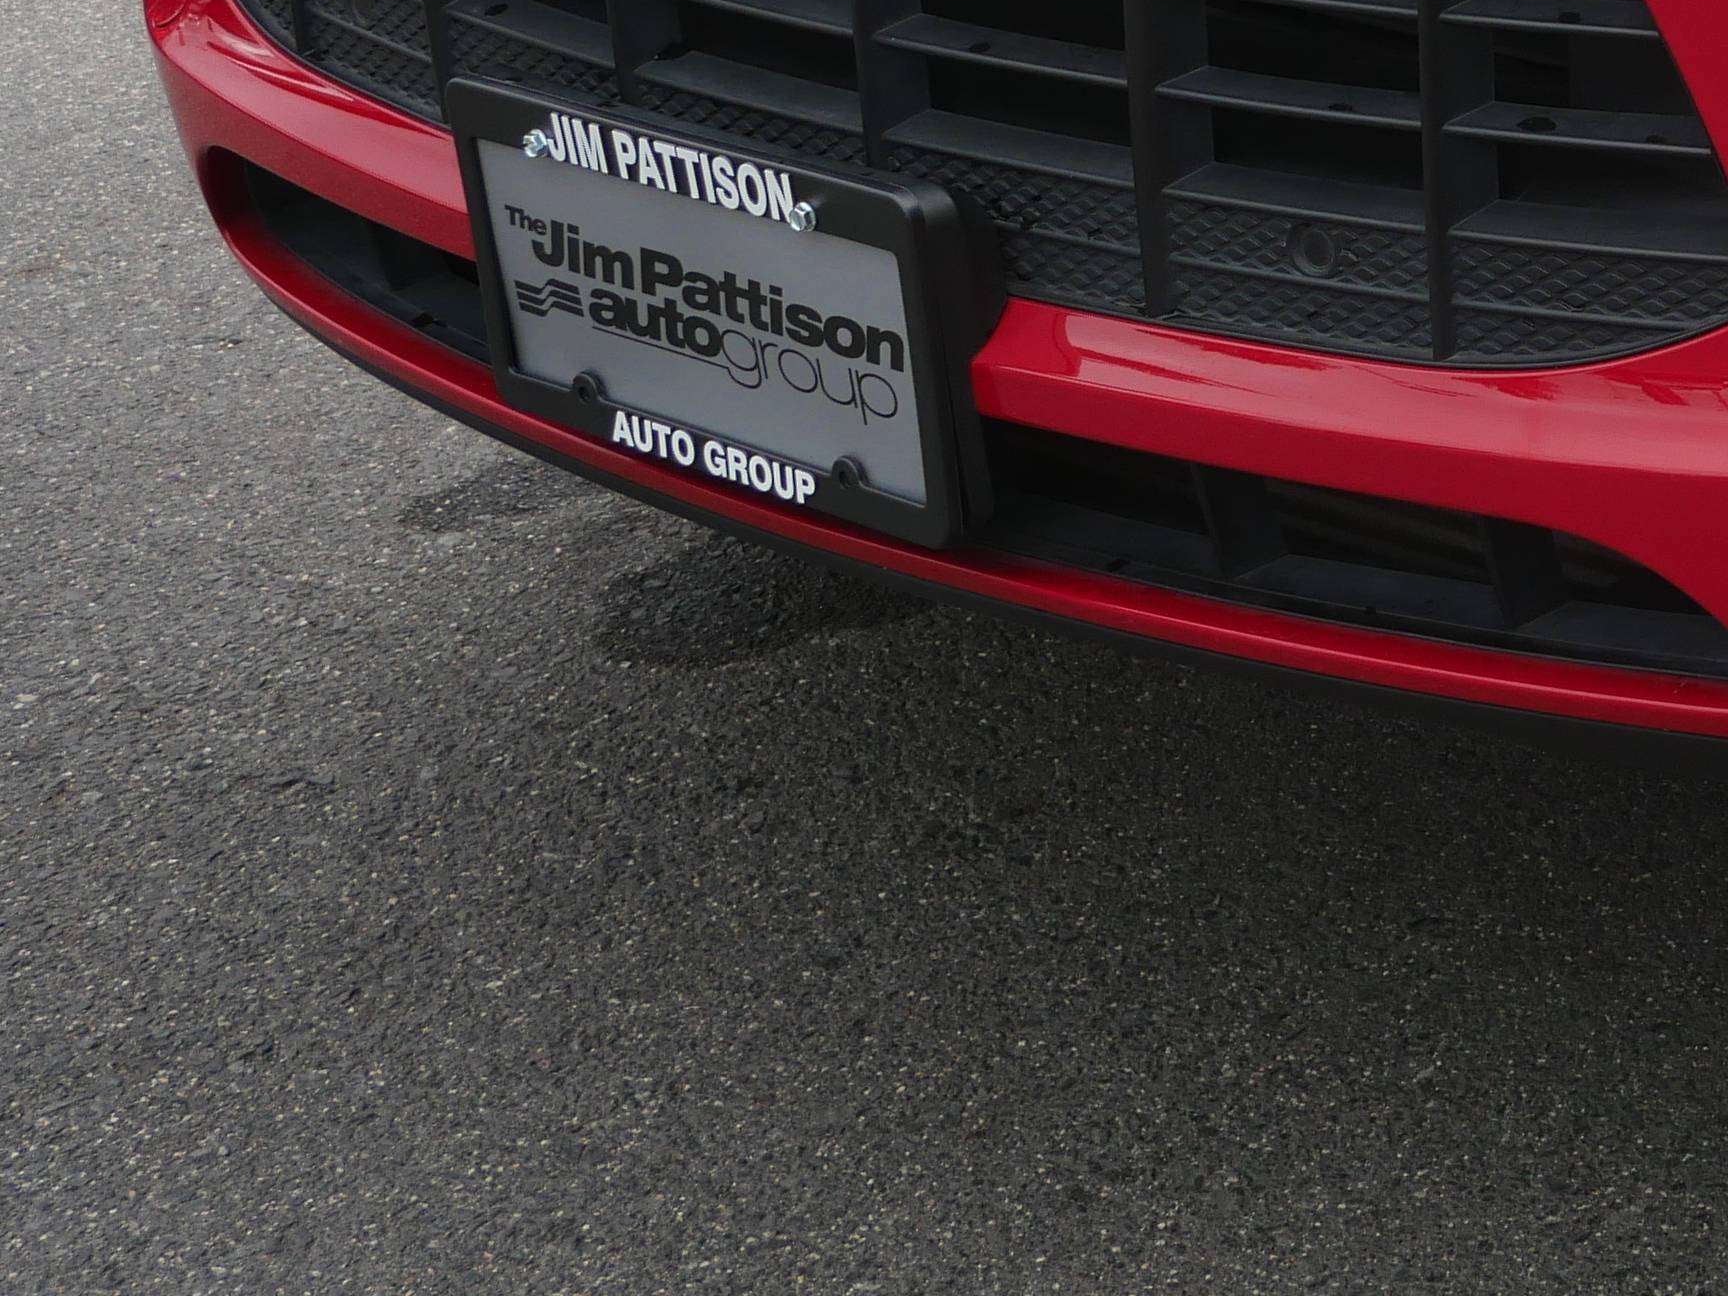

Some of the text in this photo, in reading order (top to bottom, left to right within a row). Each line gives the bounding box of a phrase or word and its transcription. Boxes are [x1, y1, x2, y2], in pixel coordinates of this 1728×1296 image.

[546, 112, 795, 223] JIM PATTISON
[505, 204, 548, 236] The
[532, 219, 904, 372] Jim Pattison
[611, 410, 816, 506] AUTO GROUP
